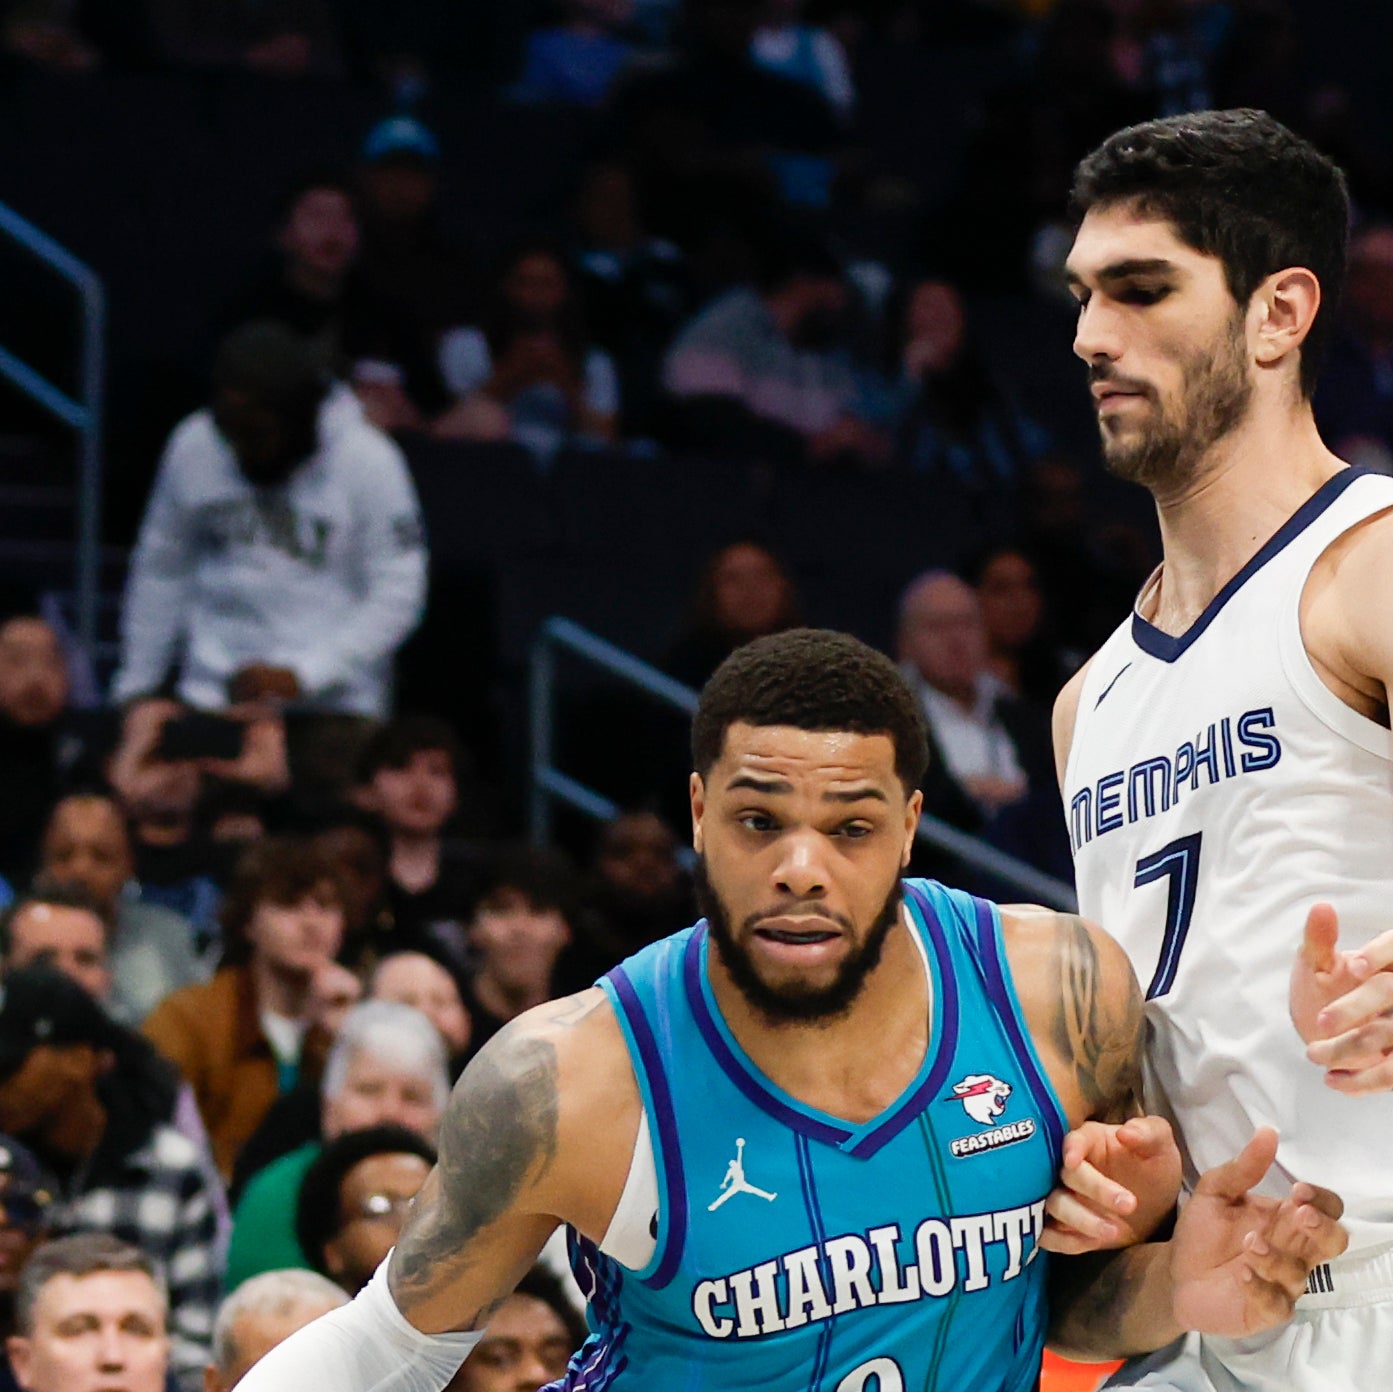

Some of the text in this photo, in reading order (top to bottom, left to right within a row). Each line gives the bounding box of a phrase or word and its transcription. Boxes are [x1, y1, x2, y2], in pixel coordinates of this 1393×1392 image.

[1071, 707, 1282, 853] MEMPHIS
[1134, 831, 1203, 1002] 7
[950, 1118, 1035, 1157] FEASTABLES
